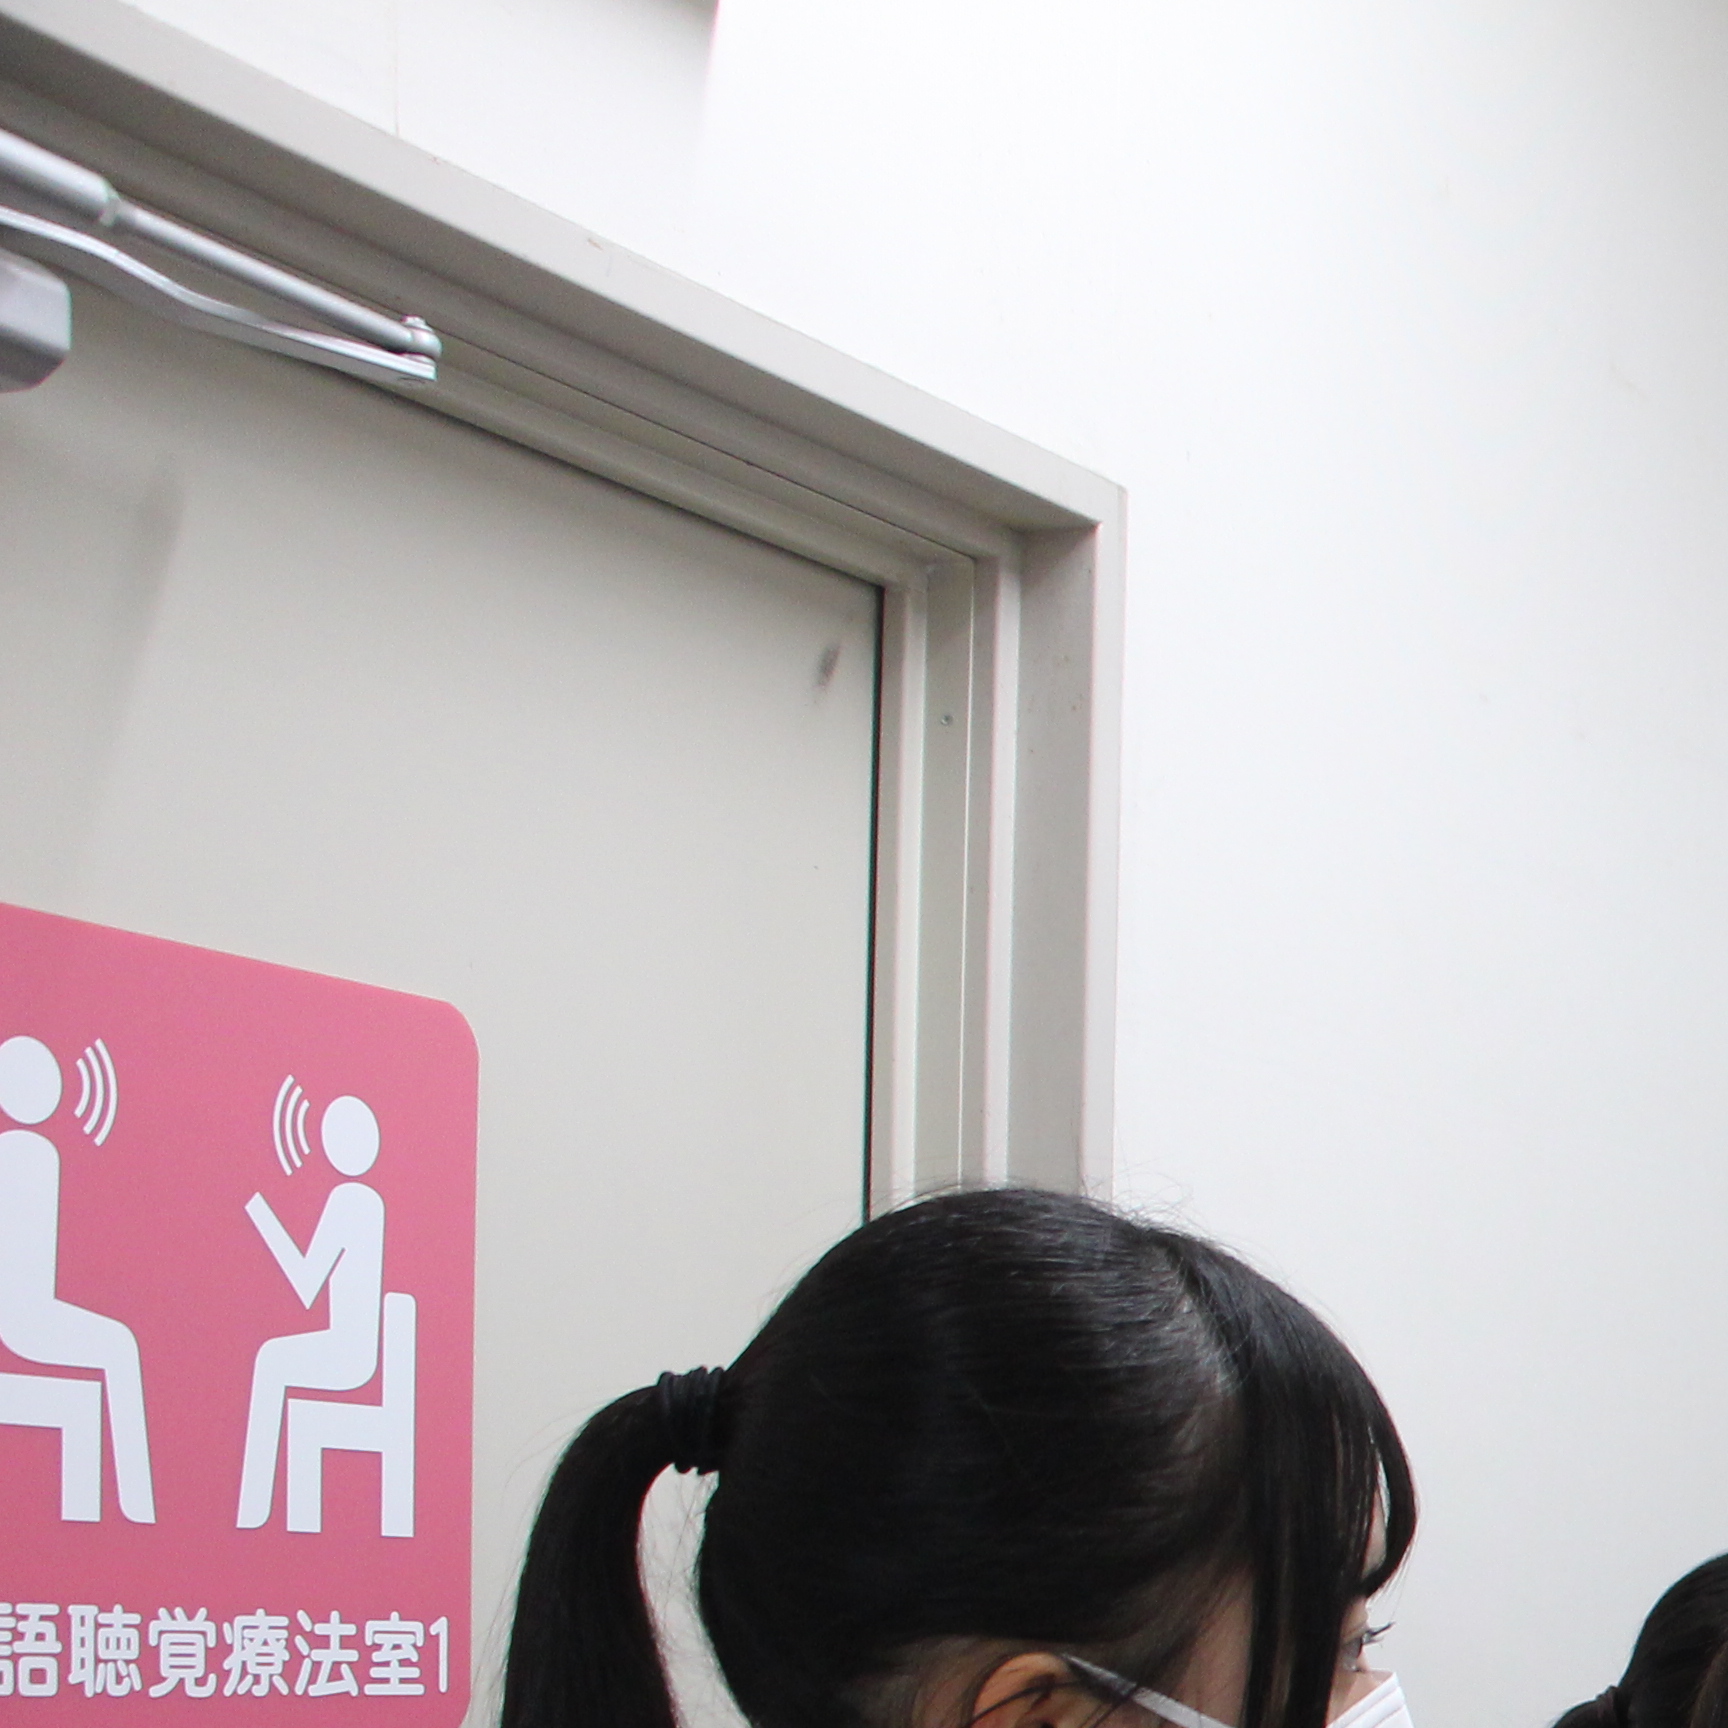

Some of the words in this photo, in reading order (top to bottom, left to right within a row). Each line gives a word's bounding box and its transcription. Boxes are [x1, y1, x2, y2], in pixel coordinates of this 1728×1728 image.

[0, 1603, 450, 1698] 語聴覚療法室1
